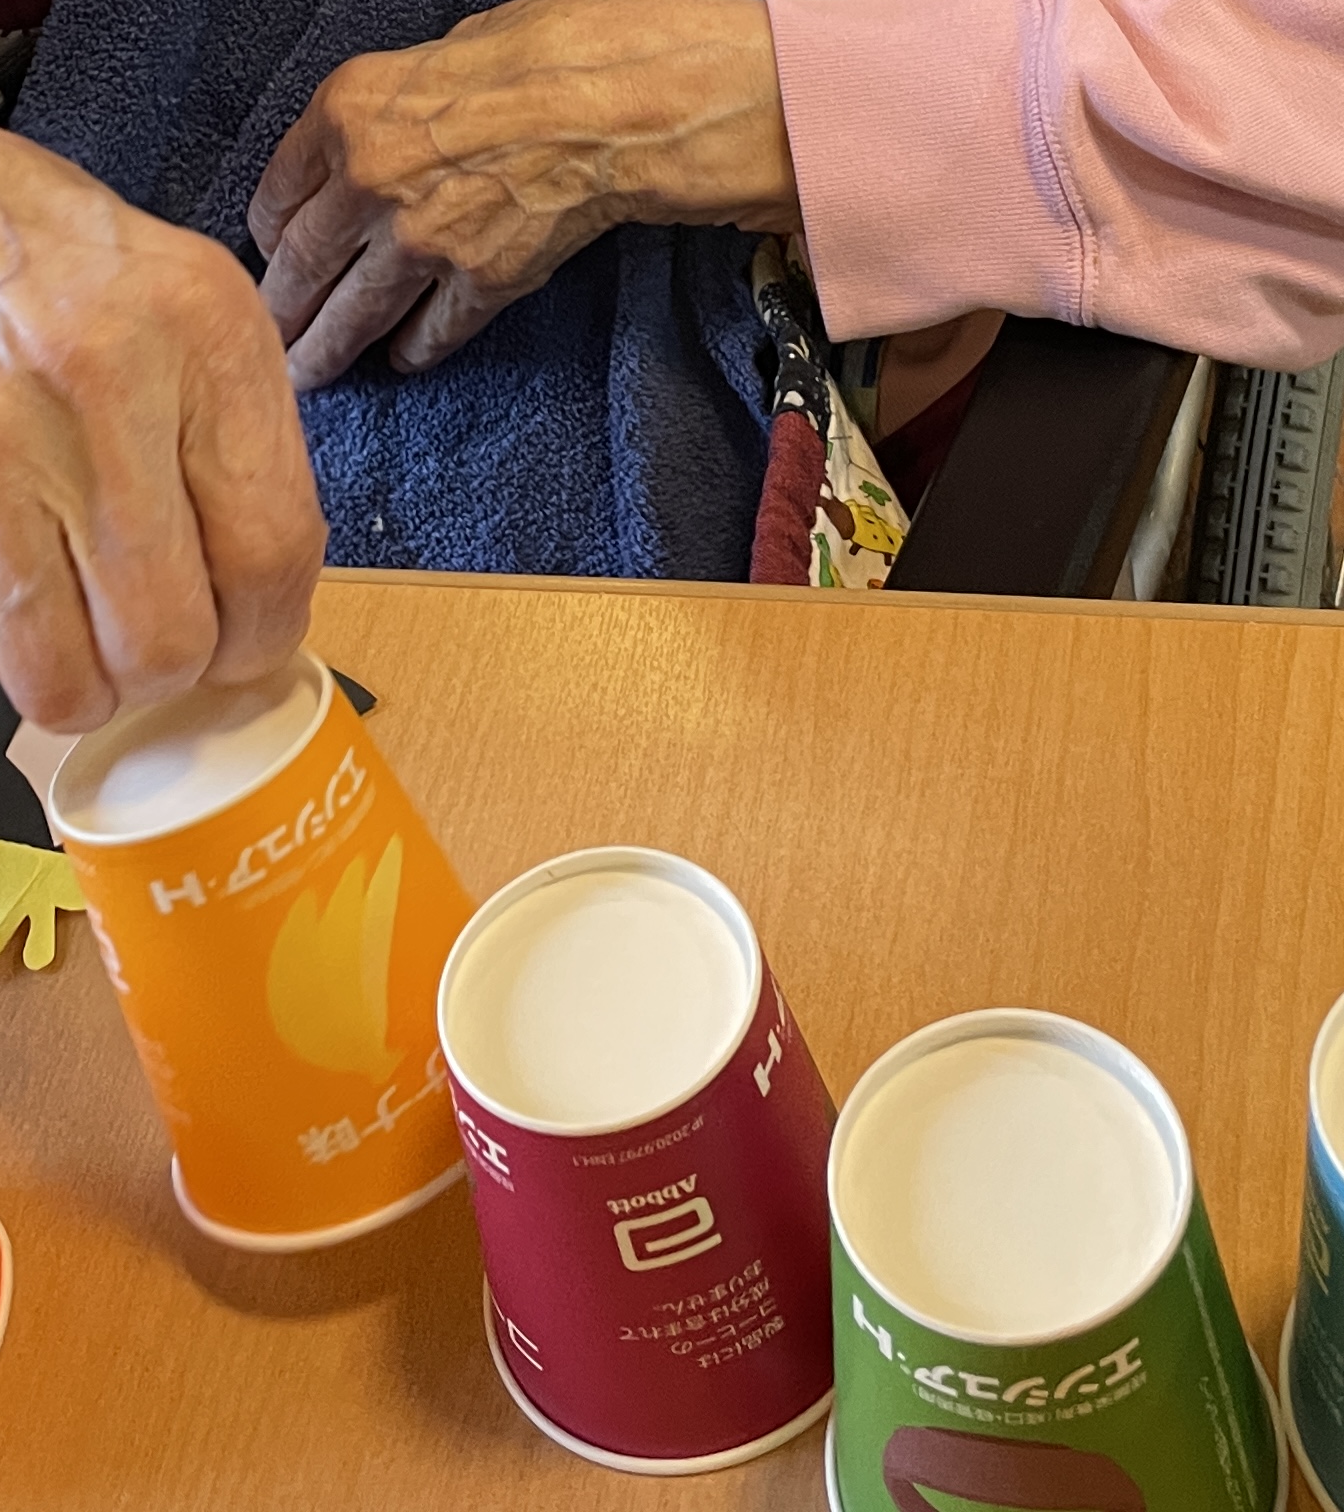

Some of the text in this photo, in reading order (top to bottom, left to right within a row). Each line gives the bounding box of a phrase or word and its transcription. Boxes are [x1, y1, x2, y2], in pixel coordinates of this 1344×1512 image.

[607, 1174, 698, 1216] Abbott
[670, 1296, 778, 1356] コーヒーの
